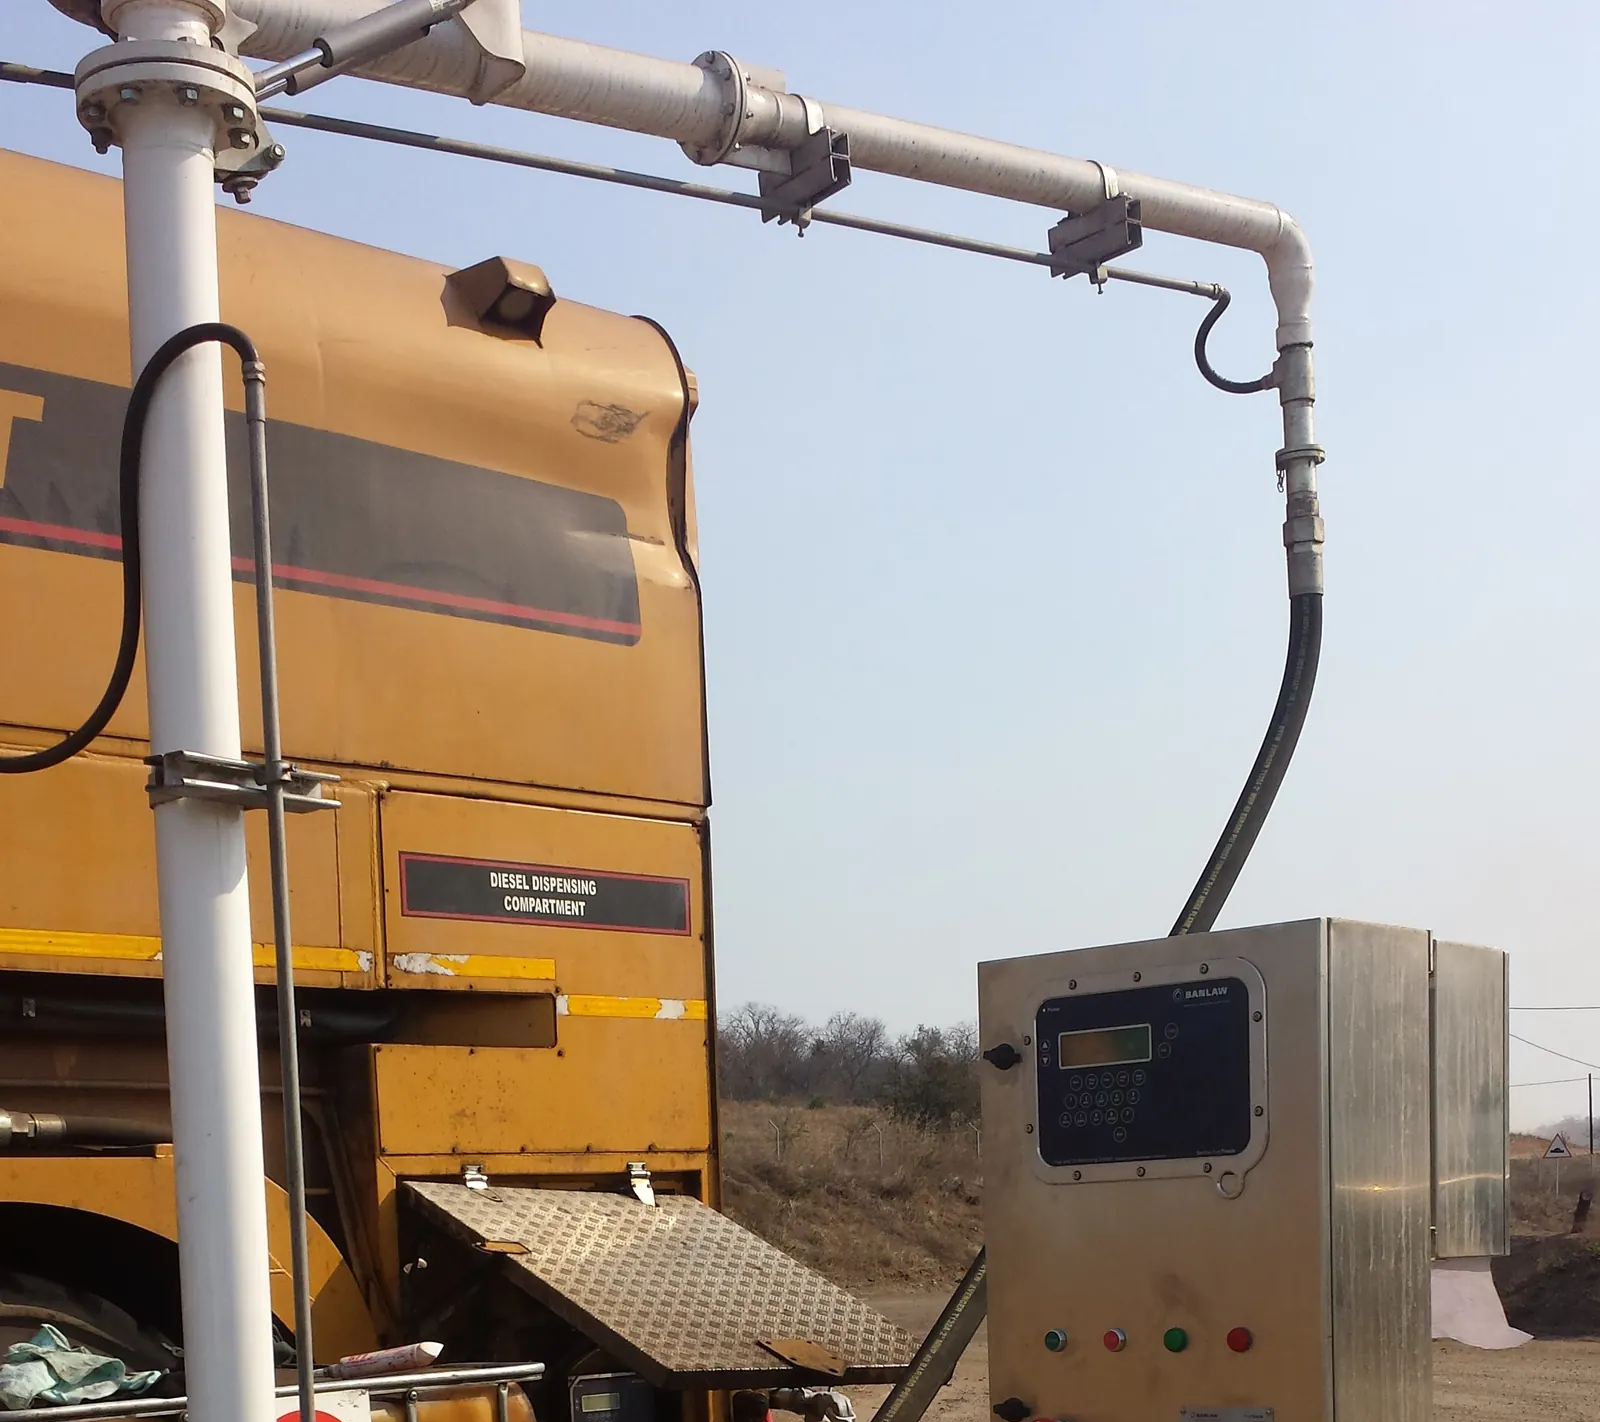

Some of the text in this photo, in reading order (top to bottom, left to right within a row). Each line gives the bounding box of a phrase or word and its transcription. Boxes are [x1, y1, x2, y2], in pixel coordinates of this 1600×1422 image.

[490, 872, 597, 896] DIESEL DISPENSING
[504, 895, 586, 917] COMPARTMENT
[1185, 986, 1228, 999] BANLAW
[953, 1282, 977, 1313] AVENGER
